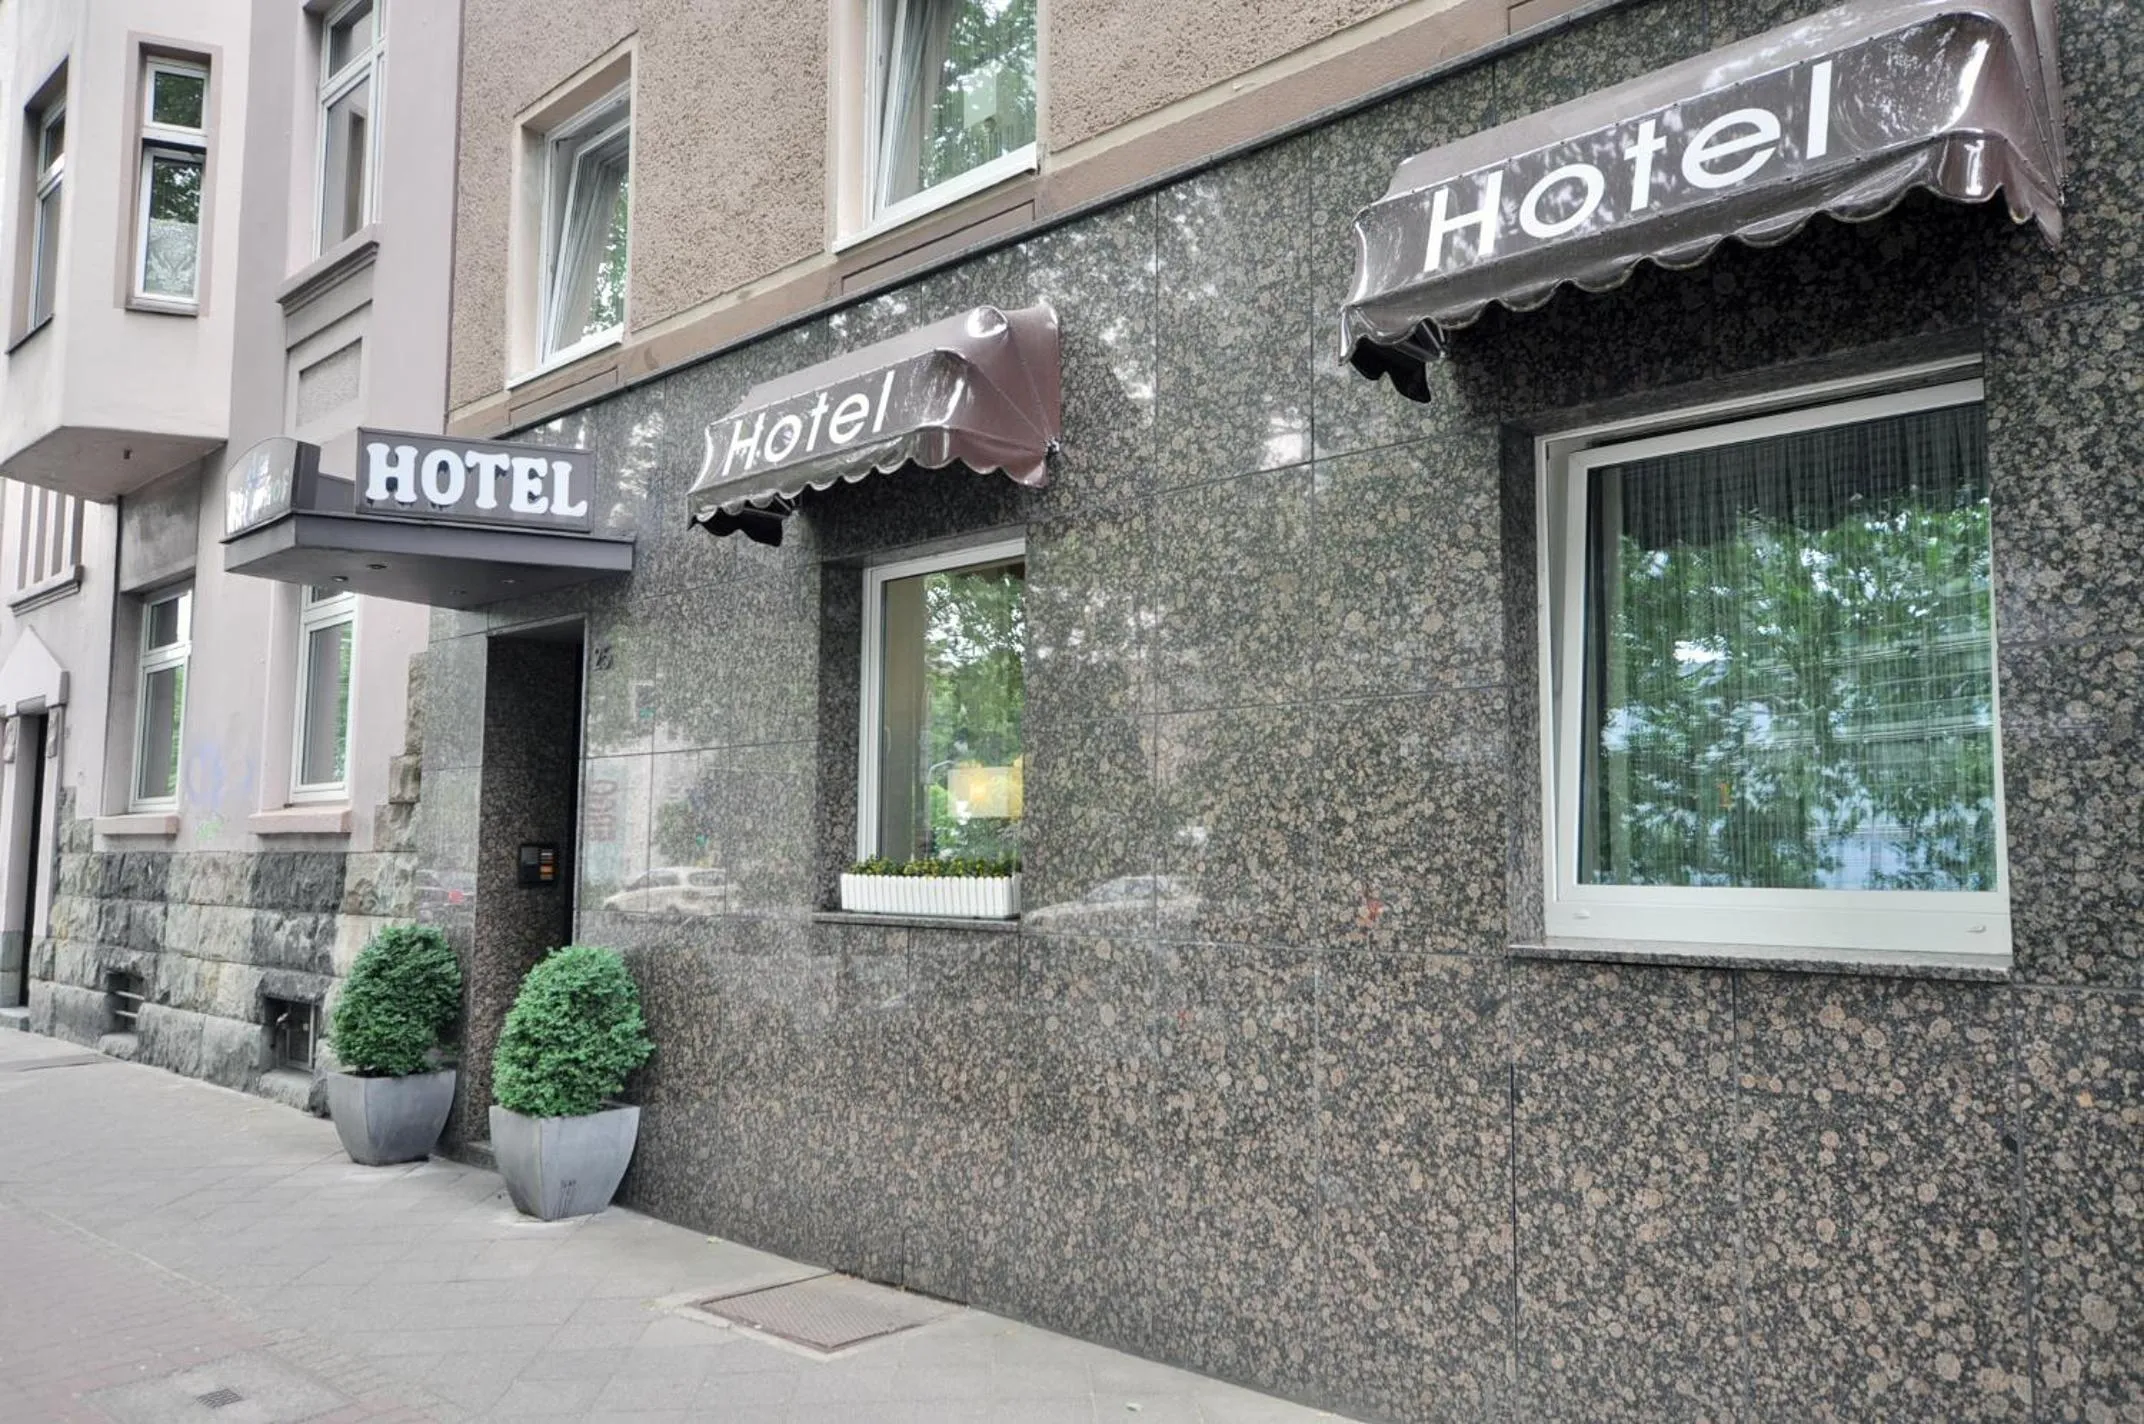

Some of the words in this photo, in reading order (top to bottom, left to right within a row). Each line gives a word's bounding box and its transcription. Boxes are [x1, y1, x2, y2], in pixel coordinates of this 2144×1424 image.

[1424, 61, 1833, 272] Hotel
[722, 370, 894, 476] Hotel
[365, 442, 588, 517] HOTEL
